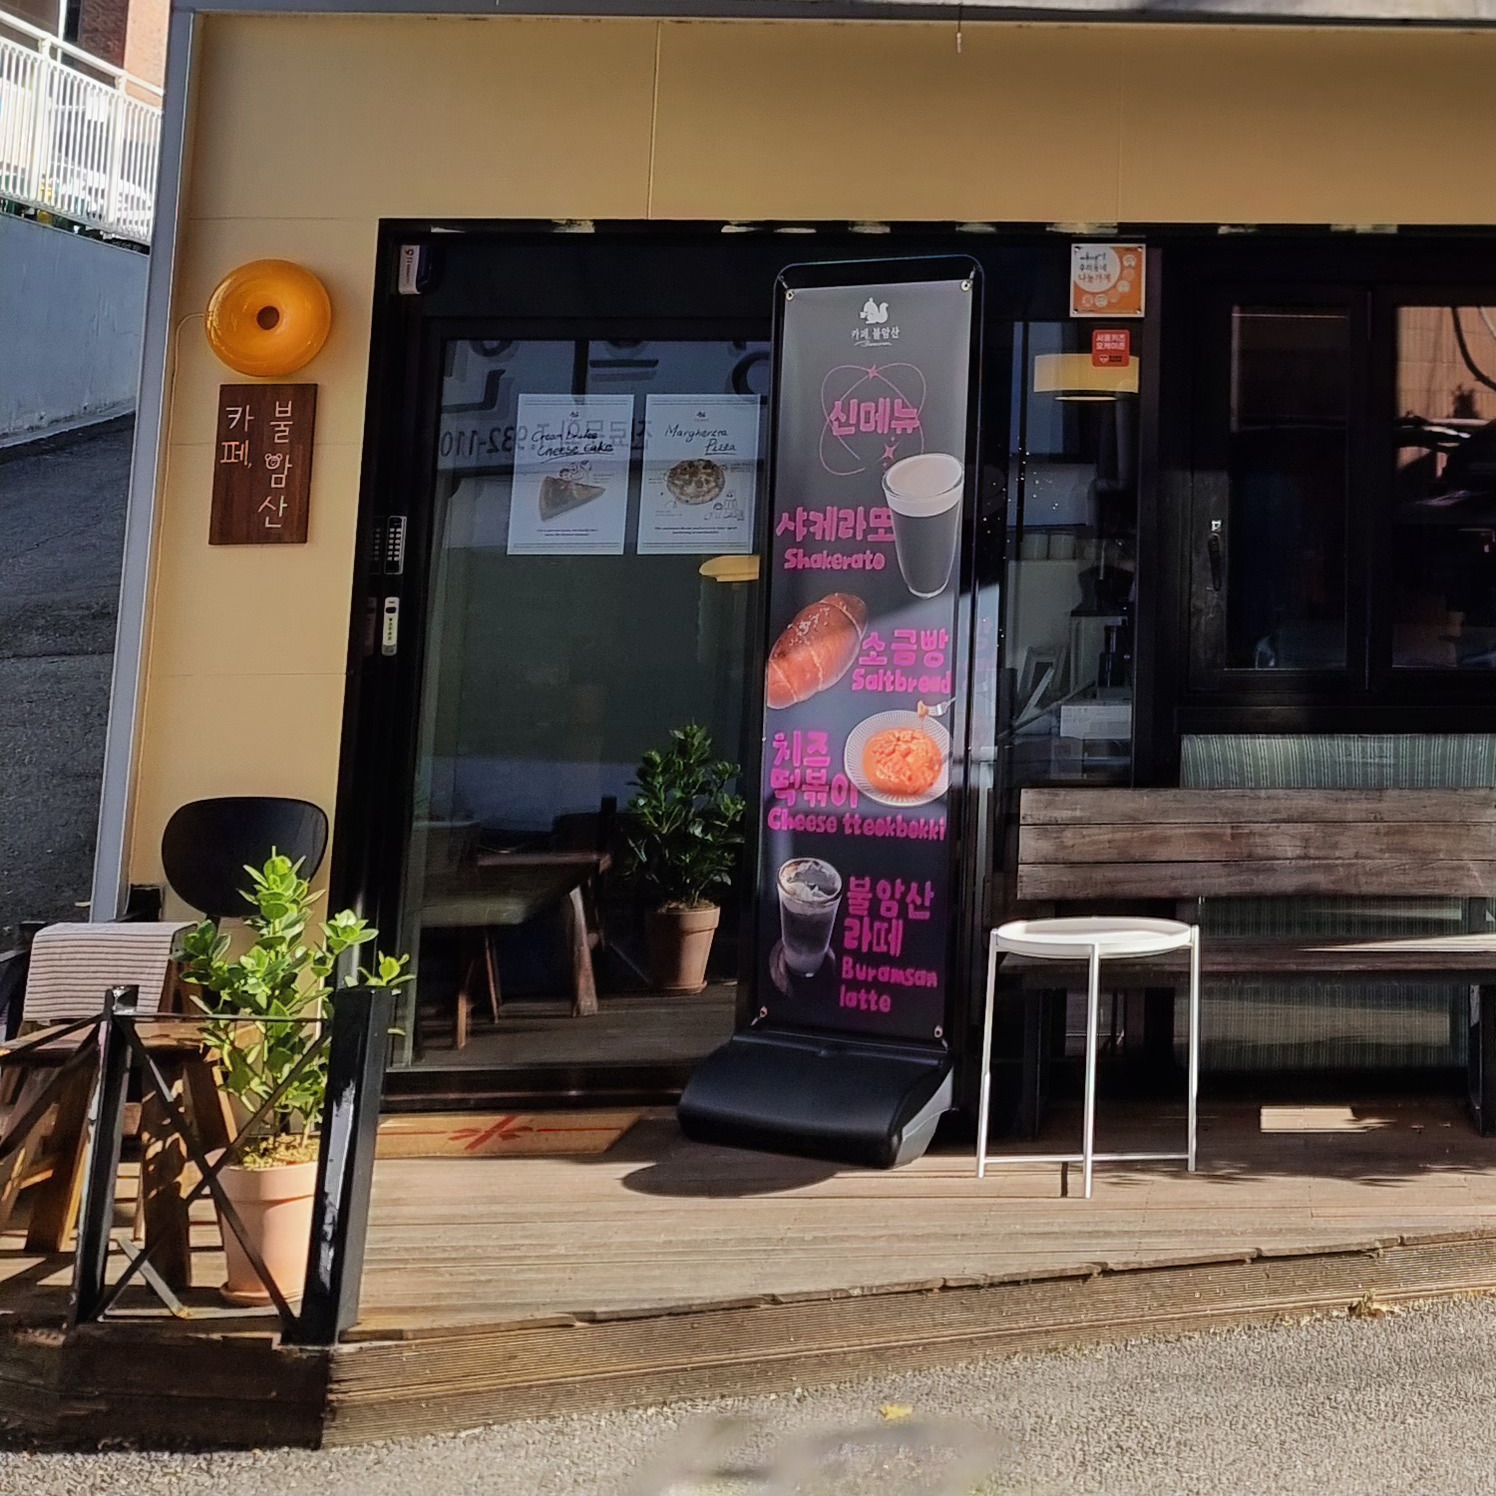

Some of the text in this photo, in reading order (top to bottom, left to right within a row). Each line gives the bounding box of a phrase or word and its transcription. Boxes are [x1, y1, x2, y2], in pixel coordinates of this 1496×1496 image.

[872, 326, 900, 340] 불암산
[829, 398, 921, 435] 신메뉴
[257, 400, 294, 528] 불암산
[775, 506, 896, 542] 샤케라또
[783, 548, 885, 571] Shakerato
[858, 628, 949, 668] 소금빵
[851, 668, 951, 694] Saltbread
[772, 730, 831, 767] 치즈
[770, 768, 859, 809] 떡볶이
[767, 807, 838, 834] Cheese
[846, 876, 935, 920] 불암산
[843, 917, 905, 957] 라떼
[841, 956, 938, 988] Buramsan
[839, 984, 892, 1013] latte
